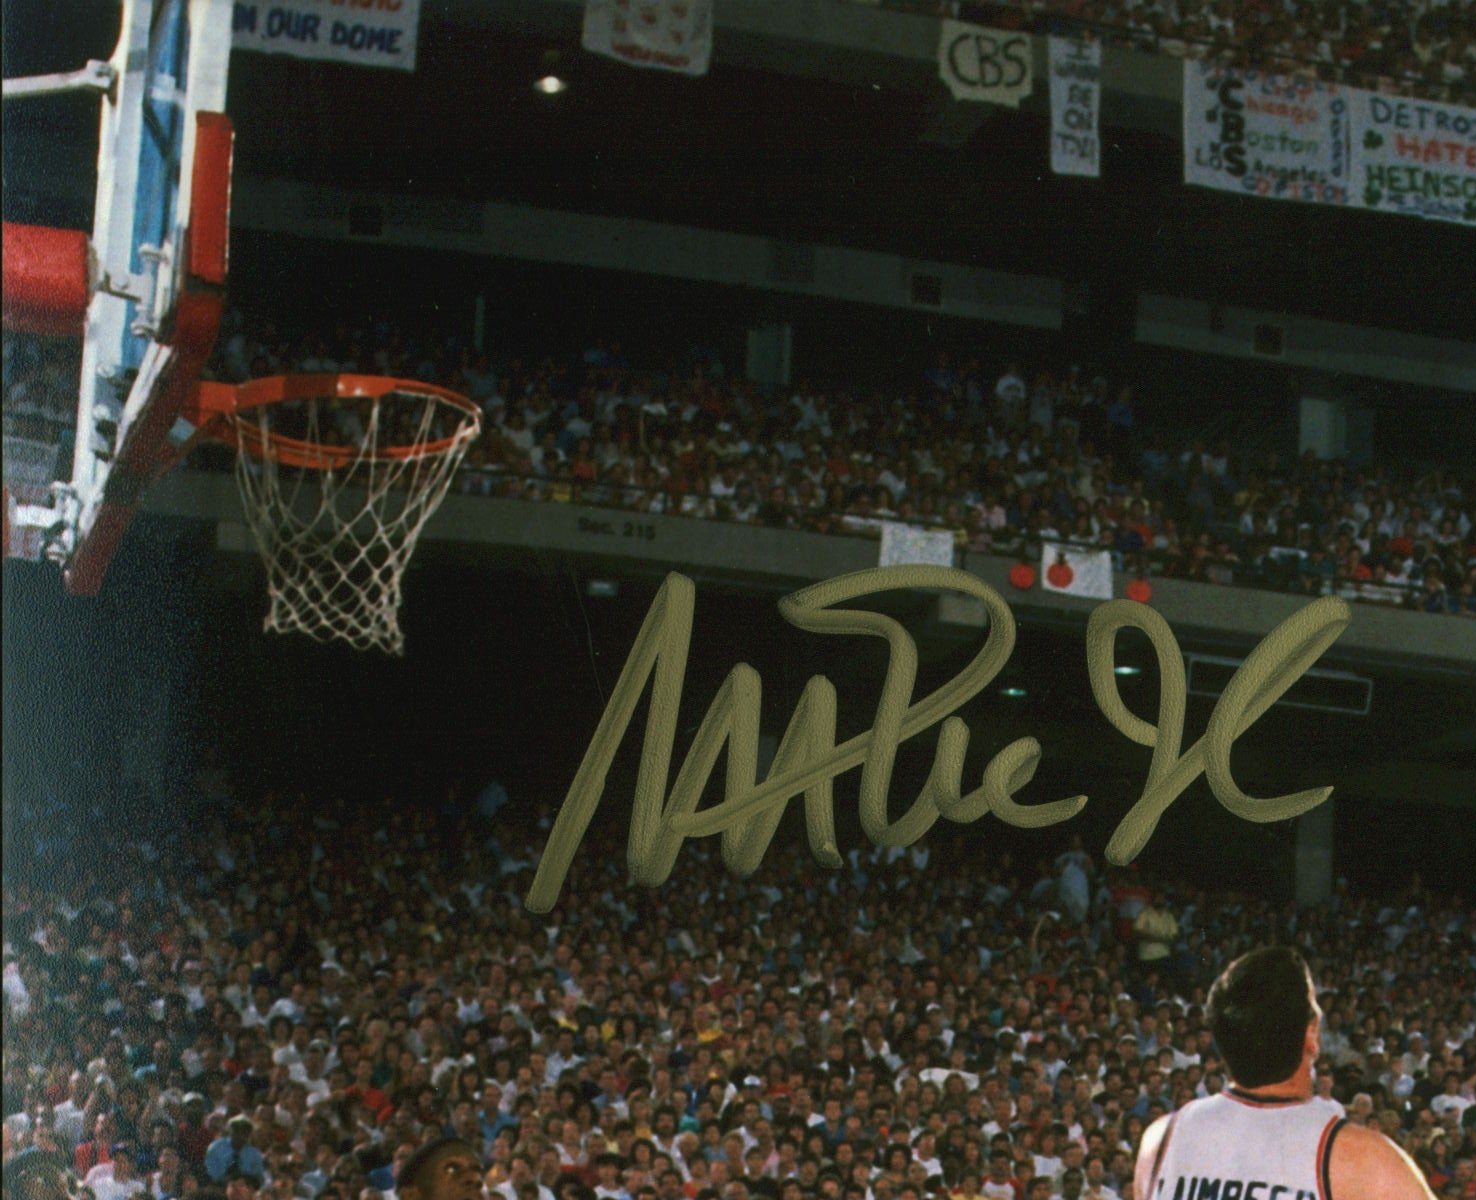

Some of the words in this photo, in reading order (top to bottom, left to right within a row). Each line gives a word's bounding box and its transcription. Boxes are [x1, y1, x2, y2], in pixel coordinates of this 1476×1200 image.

[266, 8, 320, 41] OUR
[330, 21, 402, 53] DOME
[948, 33, 1027, 88] CBS
